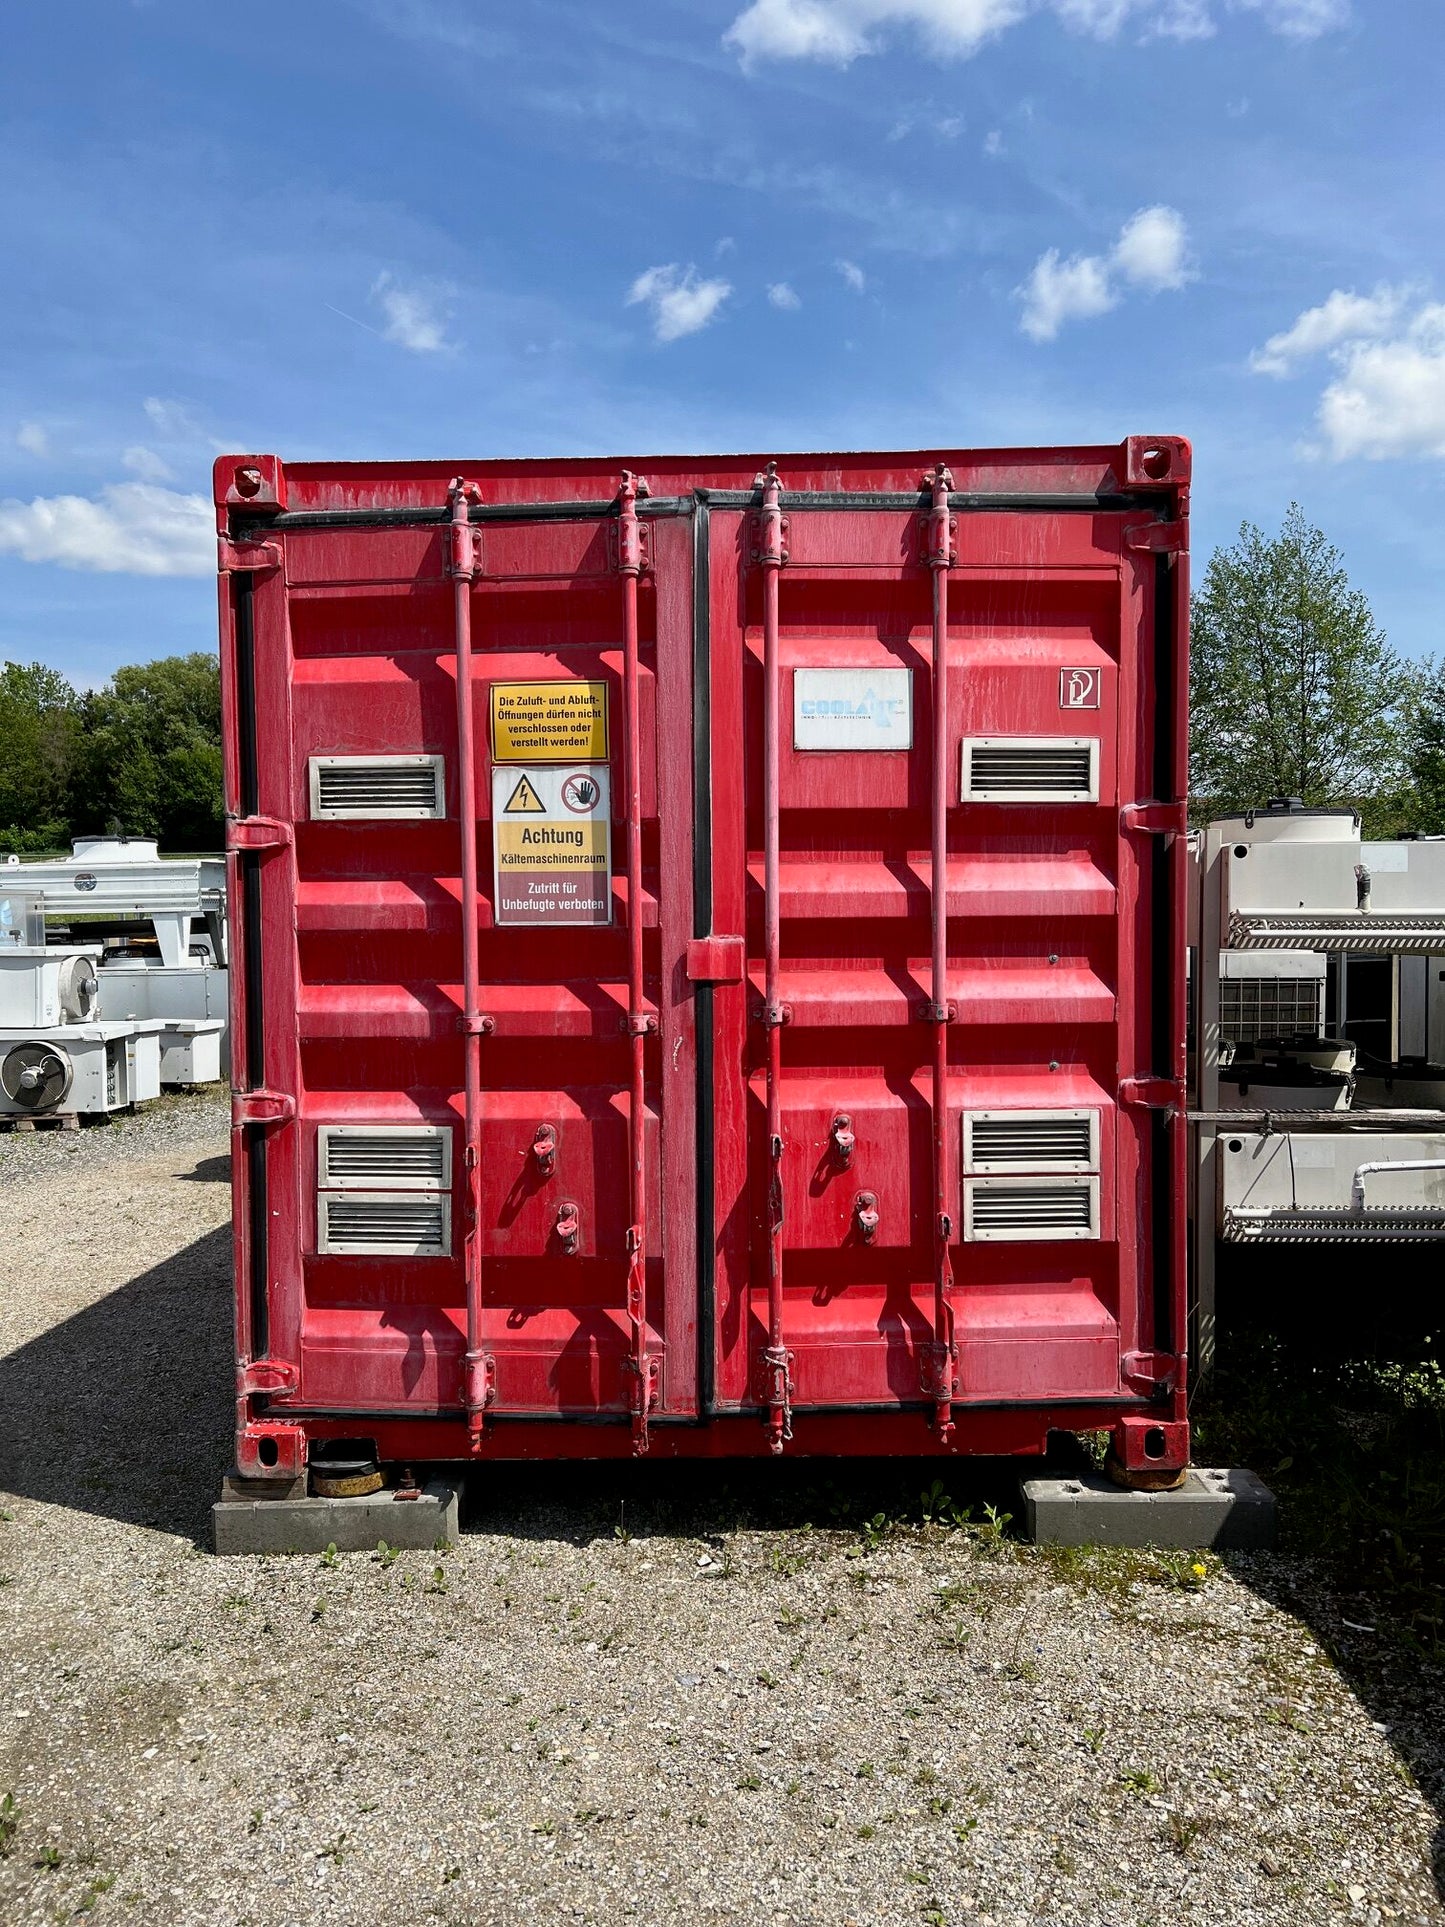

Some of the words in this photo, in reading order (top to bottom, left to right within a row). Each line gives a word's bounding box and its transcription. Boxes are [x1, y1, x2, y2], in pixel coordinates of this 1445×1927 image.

[500, 697, 514, 706] Die
[517, 696, 546, 706] Zuluft-
[549, 695, 565, 705] und
[568, 694, 599, 704] Abluft-
[498, 708, 543, 721] Öffnungen
[546, 709, 575, 719] dürfen
[578, 709, 601, 718] nicht
[508, 723, 568, 733] verschlossen
[570, 723, 591, 733] oder
[511, 737, 548, 747] verstellt
[550, 736, 589, 746] werden!
[522, 828, 583, 847] Achtung
[501, 853, 605, 864] Kältemaschinenraum
[528, 882, 559, 894] Zutritt
[562, 882, 577, 894] für
[502, 898, 555, 912] Unbefugte
[558, 898, 604, 910] verboten
